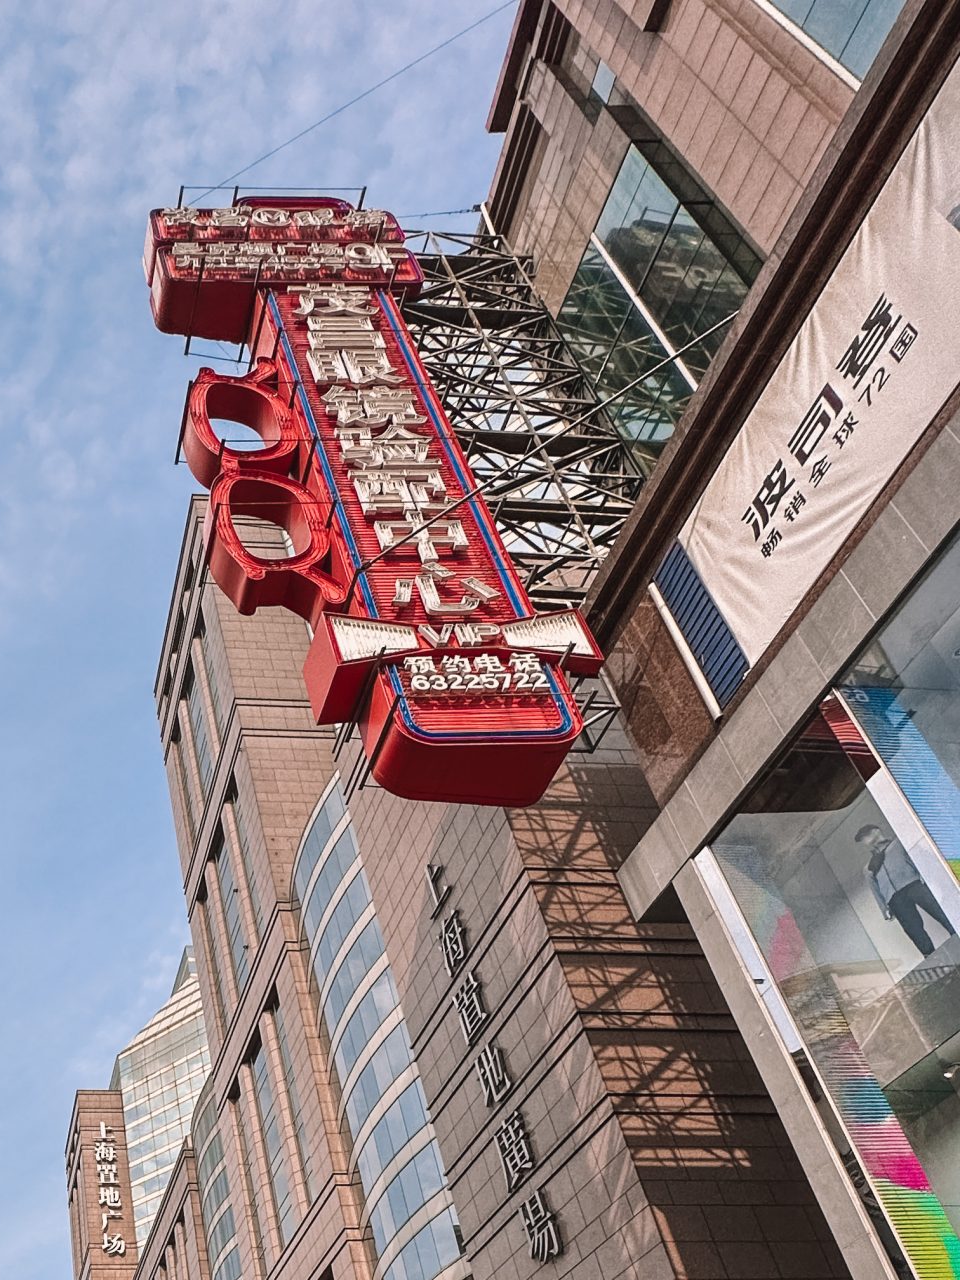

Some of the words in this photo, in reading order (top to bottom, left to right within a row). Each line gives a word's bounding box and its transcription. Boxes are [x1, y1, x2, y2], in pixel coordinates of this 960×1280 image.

[740, 291, 903, 543] 波司登
[761, 322, 919, 560] 畅销全球72国
[403, 652, 545, 674] 预约电话
[418, 623, 501, 648] VIP
[411, 672, 551, 692] 63225722
[93, 1120, 127, 1257] 上海置地广场
